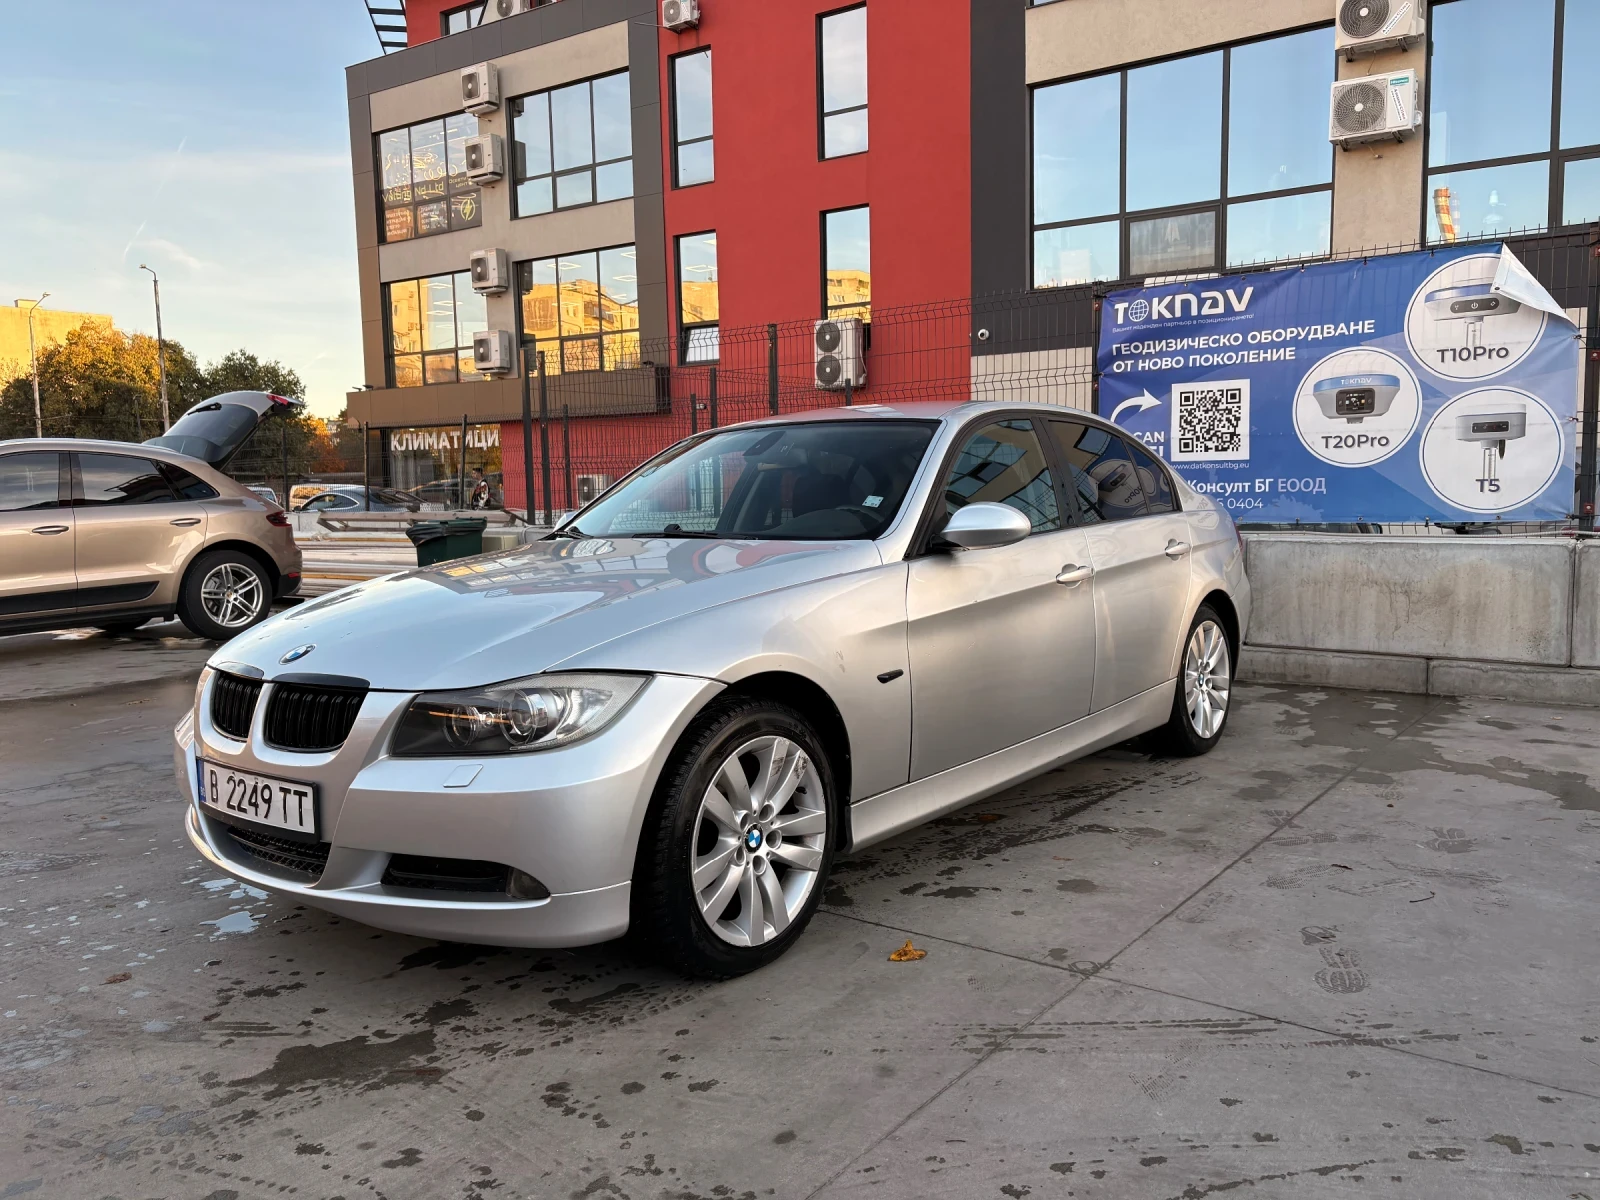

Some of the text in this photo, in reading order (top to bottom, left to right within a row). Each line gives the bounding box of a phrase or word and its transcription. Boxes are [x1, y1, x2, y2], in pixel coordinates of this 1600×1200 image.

[1163, 319, 1192, 328] партньор
[1112, 319, 1376, 356] ГЕОДИЗИЧЕСКО ОБОРУДВАНЕ
[1113, 346, 1296, 373] ОТ НОВО ПОКОЛЕНИЕ
[1437, 346, 1510, 364] T10Pro
[391, 428, 500, 451] КЛИМАТИЦИ
[1321, 434, 1390, 449] T20Pro
[1255, 478, 1274, 493] БГ
[1277, 477, 1327, 495] ЕООД
[1475, 478, 1500, 493] T5
[1227, 497, 1264, 509] 0404
[209, 769, 308, 826] B 2249 TT
